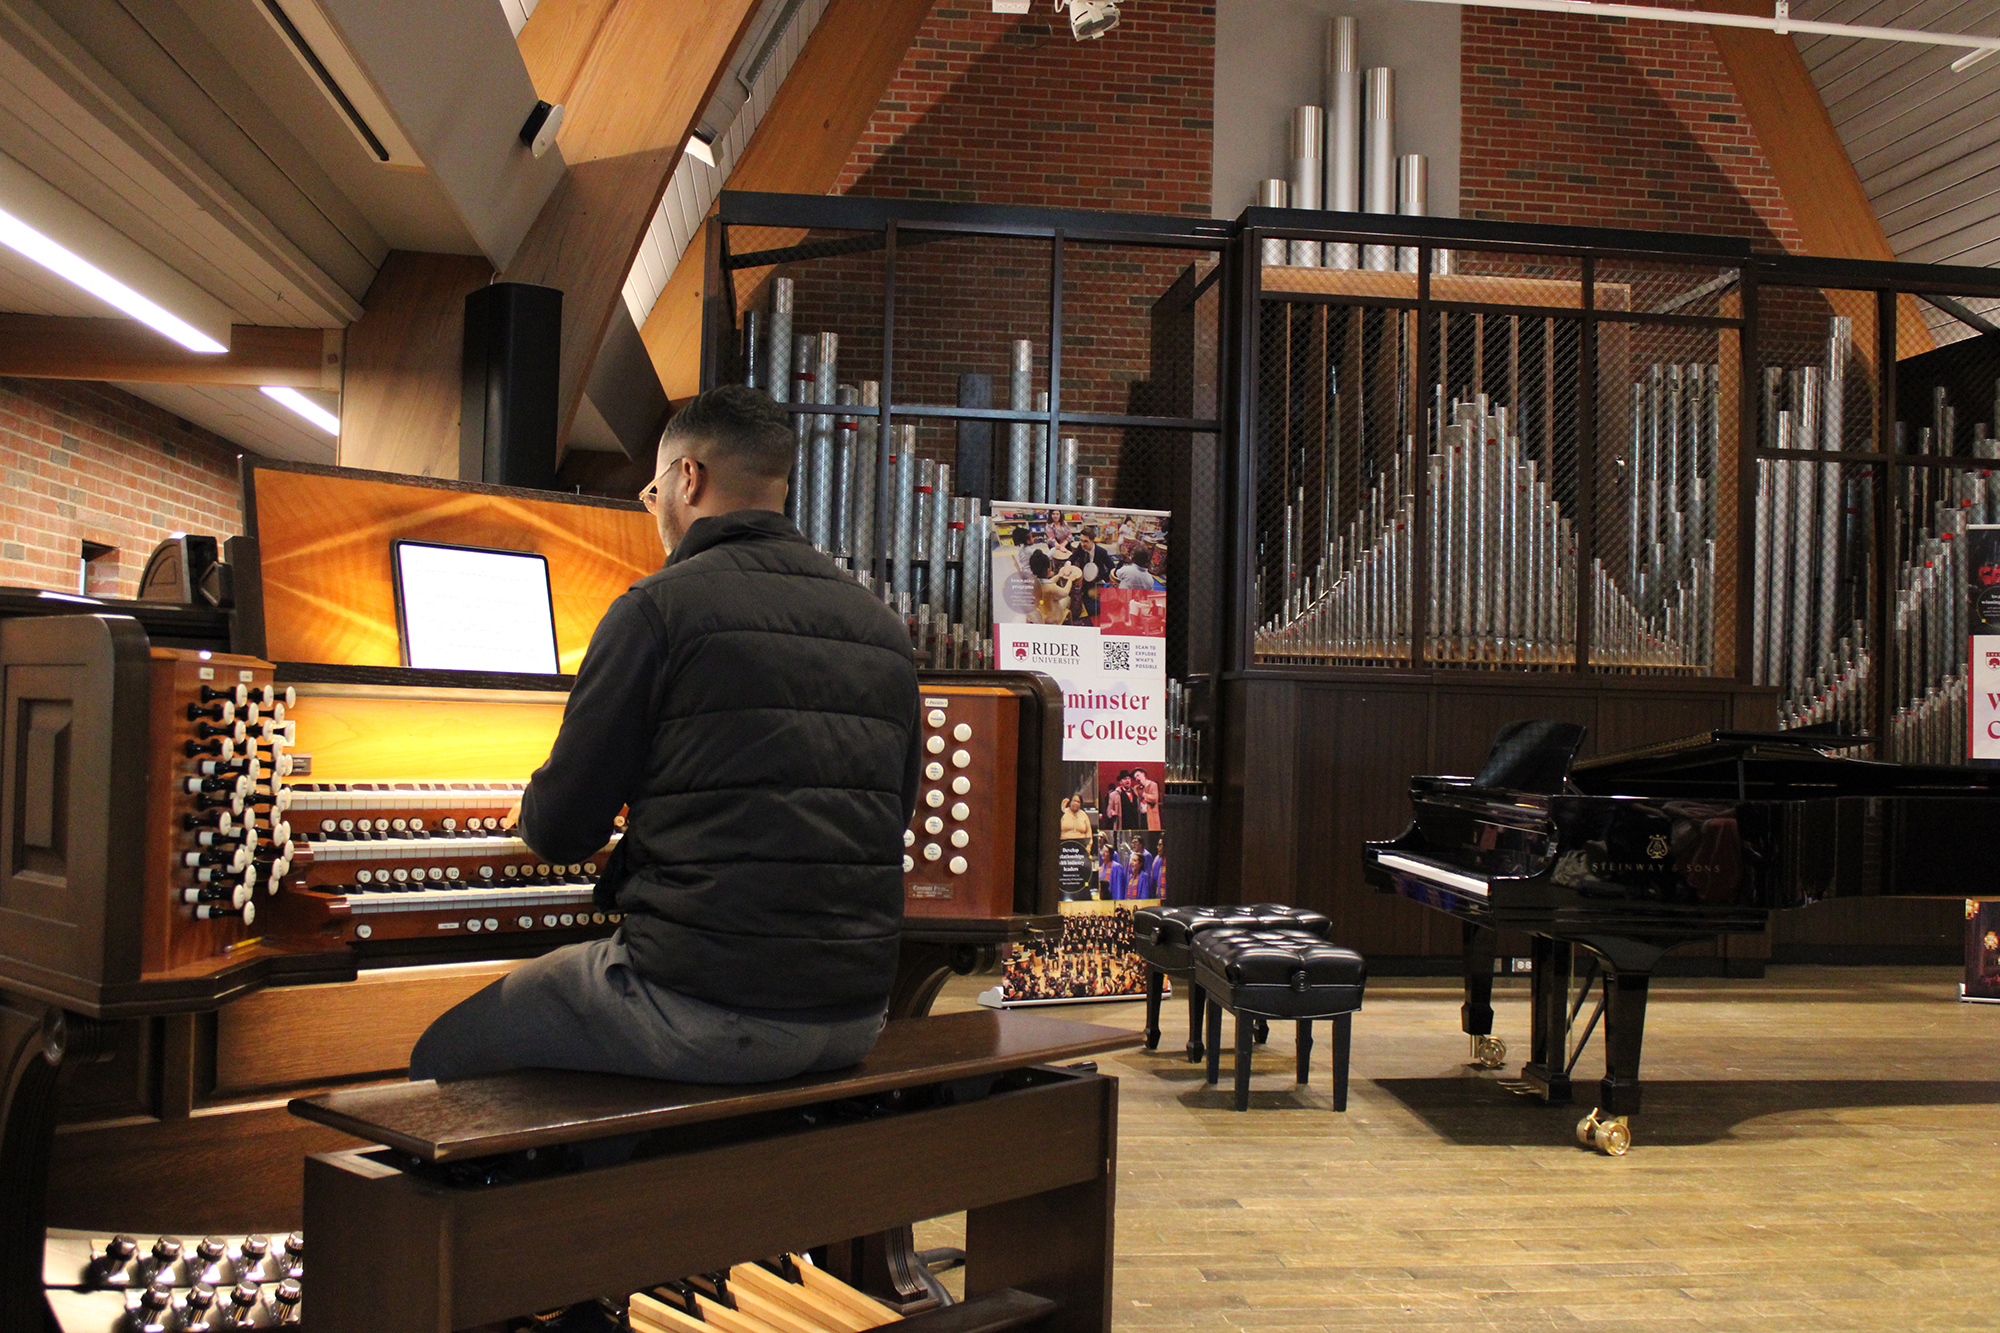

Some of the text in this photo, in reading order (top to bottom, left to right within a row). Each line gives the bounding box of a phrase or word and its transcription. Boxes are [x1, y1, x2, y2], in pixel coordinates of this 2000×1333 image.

[1032, 642, 1080, 657] RIDER
[1032, 656, 1080, 665] UNIVERSITY
[1080, 719, 1158, 746] College
[1987, 720, 2000, 739] C
[1592, 862, 1665, 873] STEINWAY
[1686, 864, 1721, 873] SONS
